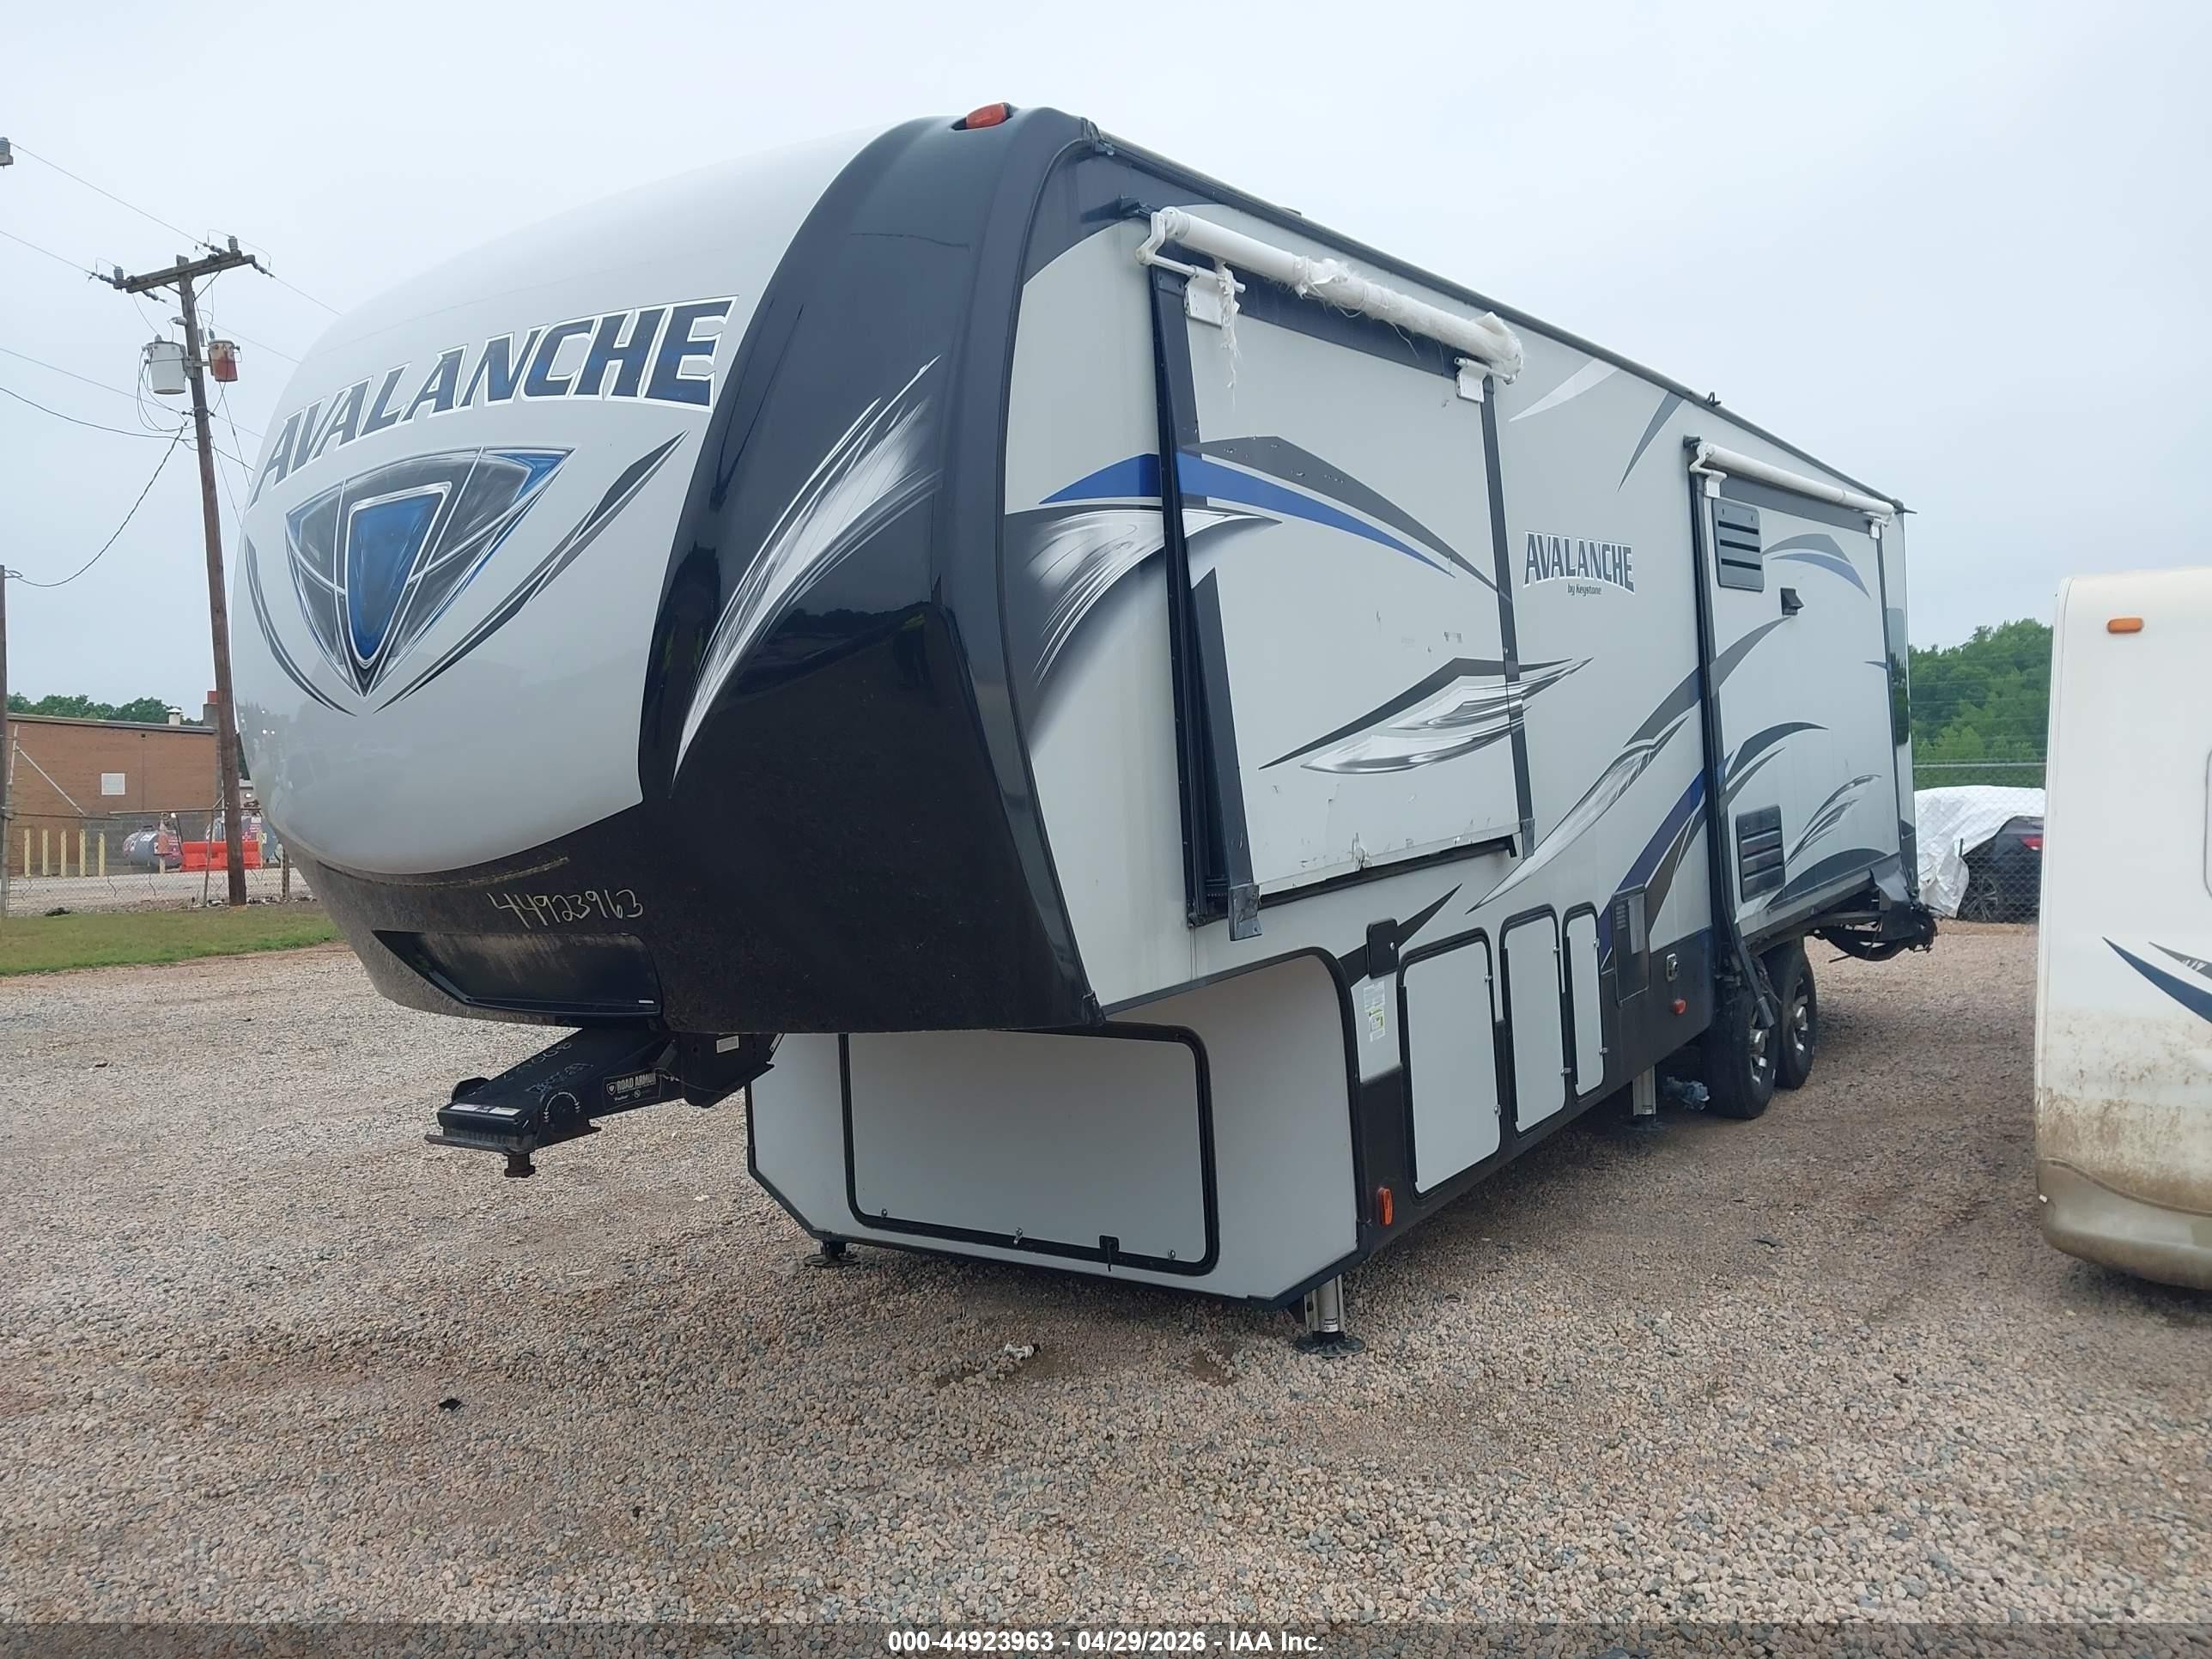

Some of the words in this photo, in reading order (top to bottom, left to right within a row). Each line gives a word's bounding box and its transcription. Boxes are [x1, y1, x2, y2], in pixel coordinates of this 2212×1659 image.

[246, 295, 738, 512] AVALANCHE
[1523, 531, 1635, 594] AVALANCHE
[1567, 583, 1575, 596] by
[1576, 584, 1602, 597] Keystone
[486, 889, 644, 929] 44923963
[617, 1078, 634, 1092] ROAD
[635, 1072, 657, 1087] ARMOR
